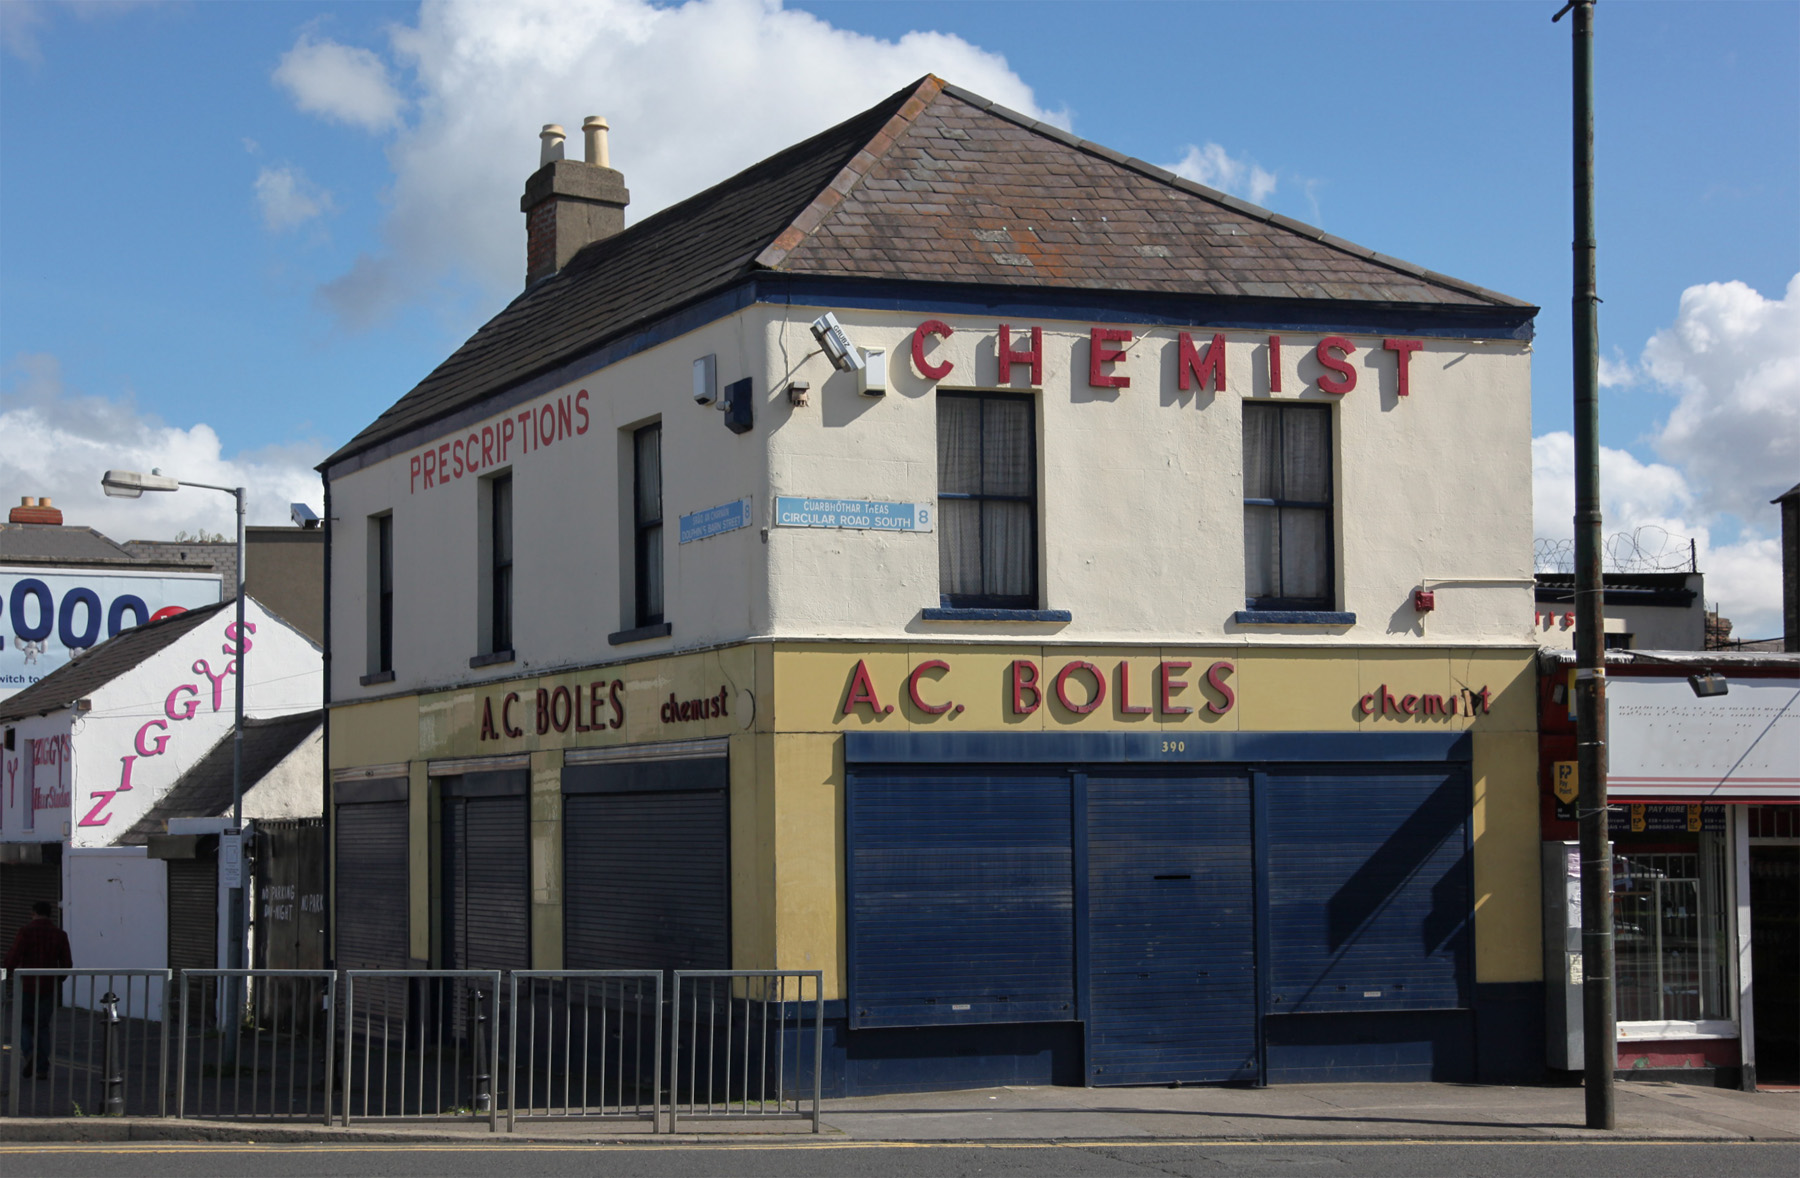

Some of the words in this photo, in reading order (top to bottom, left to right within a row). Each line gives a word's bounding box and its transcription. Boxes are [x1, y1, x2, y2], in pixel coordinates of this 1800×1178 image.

[911, 320, 1423, 397] CHEMIST
[410, 389, 590, 494] PRESCRIPTIONS
[722, 515, 741, 530] STREET
[745, 504, 750, 519] 8
[782, 512, 835, 524] CIRCULAR
[840, 515, 870, 526] ROAD
[874, 517, 911, 528] SOUTH
[918, 509, 929, 524] 8
[0, 578, 149, 650] 000
[480, 692, 523, 741] A.C.
[536, 679, 624, 735] BOLES
[660, 685, 729, 723] chemist
[843, 659, 965, 714] A.C.
[1013, 659, 1235, 714] BOLES
[1361, 684, 1492, 715] chemit
[78, 621, 257, 827] ZIGGYS
[1162, 741, 1185, 752] 390
